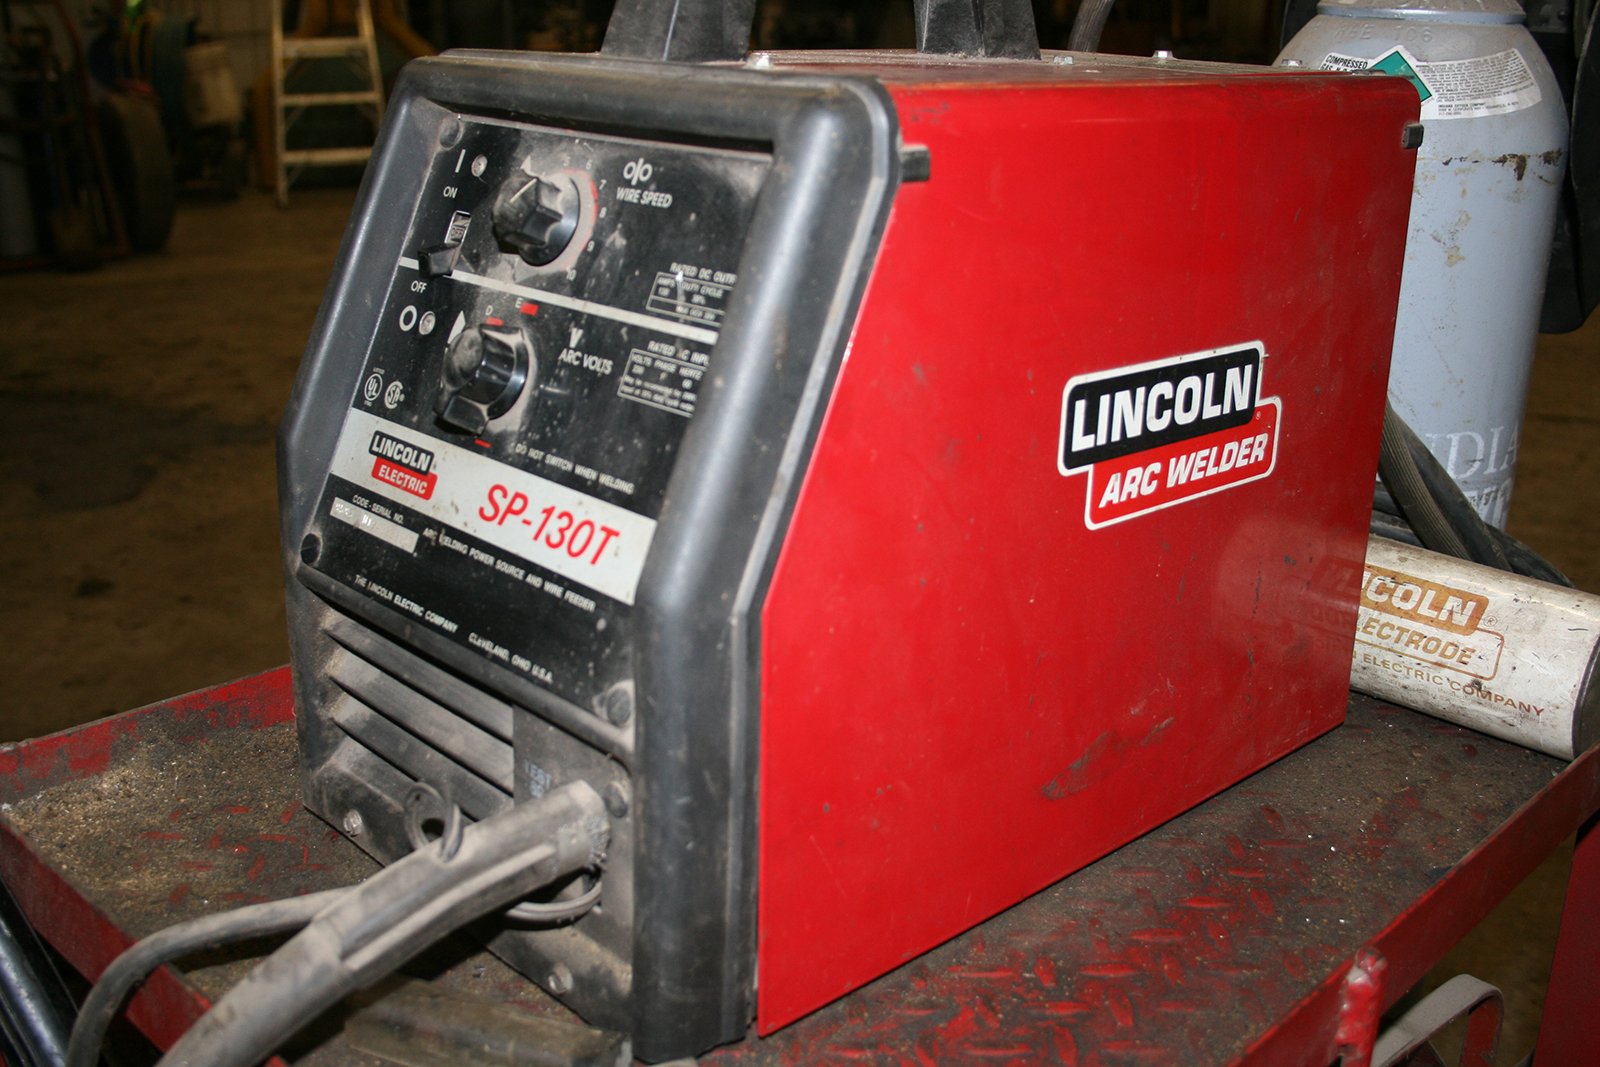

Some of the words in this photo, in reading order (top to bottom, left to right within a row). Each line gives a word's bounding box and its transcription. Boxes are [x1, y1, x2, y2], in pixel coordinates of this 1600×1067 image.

[1325, 54, 1368, 70] COMPRESSED
[443, 186, 458, 198] ON
[616, 188, 640, 205] WIRE
[641, 190, 673, 208] SPEED
[587, 240, 595, 252] 9
[566, 268, 576, 280] 10
[698, 268, 712, 280] DC
[410, 280, 428, 294] OFF
[486, 305, 494, 316] D
[570, 328, 584, 348] V
[647, 340, 676, 356] RATED
[558, 350, 580, 367] ARC
[582, 352, 614, 374] VOLTS
[1071, 364, 1253, 452] LINCOLN
[372, 434, 431, 472] LINCOLN
[515, 444, 528, 454] DO
[528, 448, 546, 460] NOT
[544, 454, 574, 472] SWITCH
[574, 464, 598, 480] WHEN
[598, 472, 635, 494] WELDING
[1098, 462, 1162, 508] ARC
[1166, 433, 1269, 488] WELDER
[378, 464, 428, 495] ELECTRIC
[393, 512, 404, 524] NO.
[478, 484, 620, 565] SP-130T
[469, 547, 496, 566] POWER
[495, 559, 526, 581] SOURCE
[525, 572, 544, 588] AND
[544, 580, 565, 598] WIRE
[564, 590, 596, 613] FEEDER
[354, 574, 368, 588] THE
[368, 581, 394, 600] LINCOLN
[394, 594, 425, 618] ELECTRIC
[424, 610, 459, 634] COMPANY
[512, 654, 532, 672] OHIO
[1363, 654, 1444, 686] ELECTRIC
[1450, 680, 1544, 717] COMPANY
